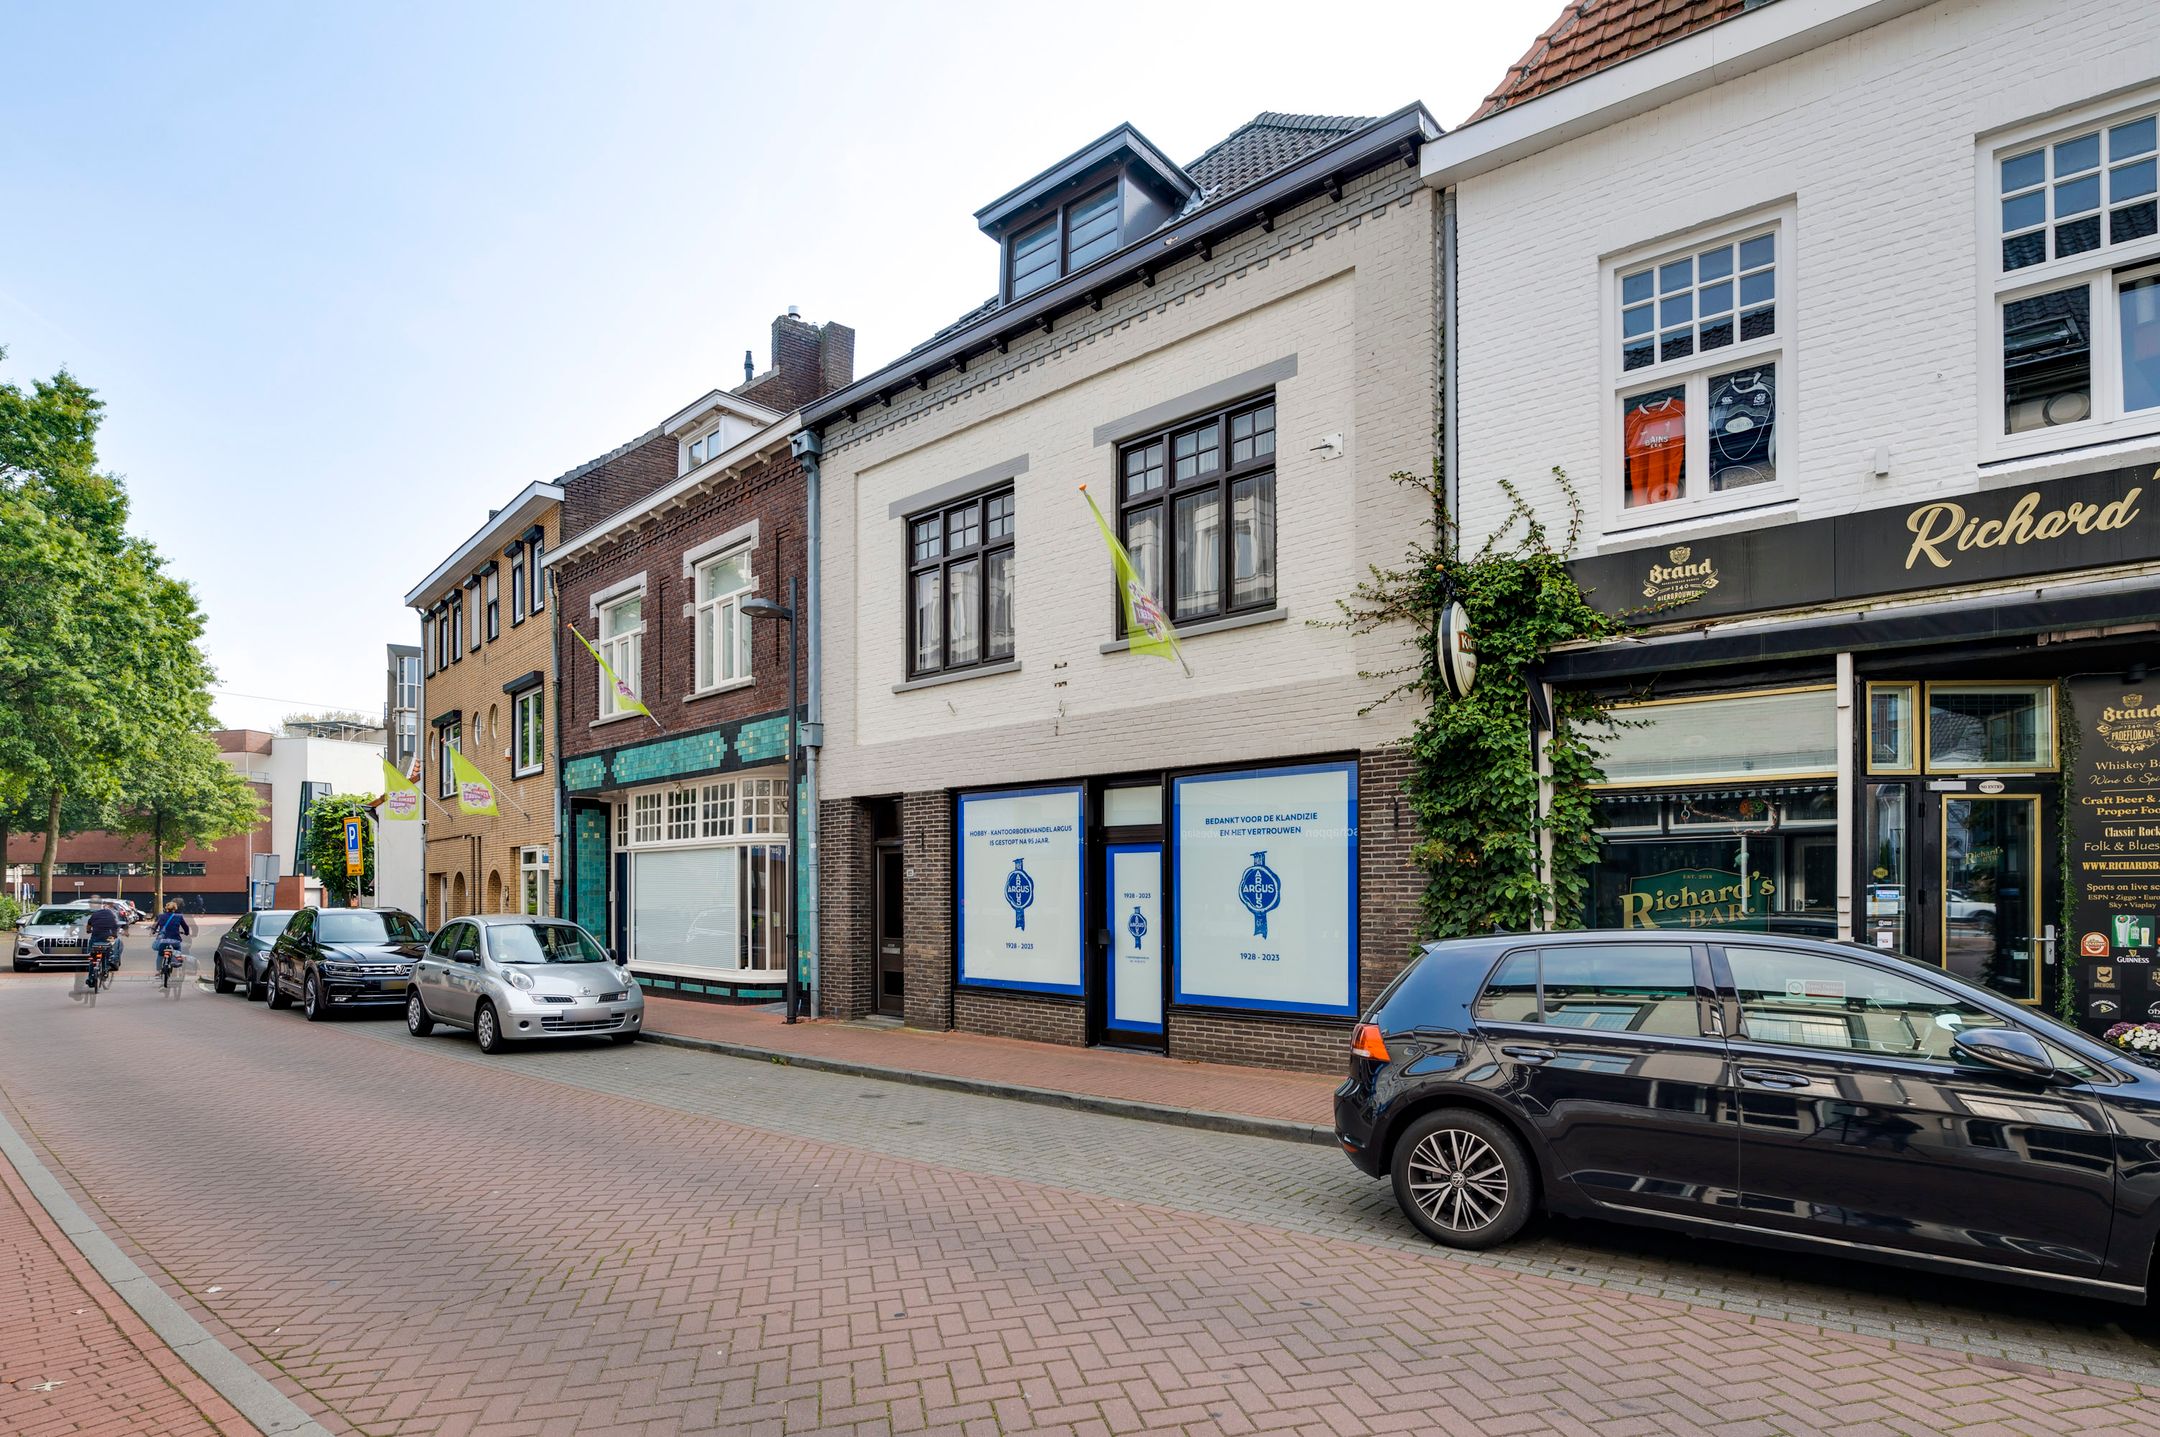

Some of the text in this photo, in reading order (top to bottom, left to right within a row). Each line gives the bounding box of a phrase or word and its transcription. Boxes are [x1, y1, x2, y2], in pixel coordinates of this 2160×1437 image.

[1649, 558, 1713, 584] Brand
[2103, 704, 2160, 722] Brand
[2111, 729, 2155, 740] PROEFLOKAAL
[2096, 759, 2160, 771] Whiskey B
[2089, 774, 2120, 785] Wine
[2123, 774, 2136, 783] &
[2082, 794, 2156, 805] Craft Beer &
[2096, 807, 2138, 817] Proper
[1205, 812, 1318, 825] BEDANKT VOOR DE KLANDIZIE
[991, 827, 1052, 836] KANTOORBOEKHANDEL
[1053, 825, 1073, 833] ARGUS
[1220, 829, 1231, 837] EN
[1231, 828, 1246, 836] HET
[1247, 826, 1302, 836] VERTROUWEN
[2105, 826, 2136, 838] Classic
[348, 826, 356, 848] P
[995, 838, 1019, 847] GESTOPT
[2084, 839, 2160, 851] Folk & Blues
[2082, 861, 2160, 871] WWW.RICHARDSB
[1007, 885, 1030, 893] ARGUS
[1242, 884, 1275, 893] ARGUS
[2086, 883, 2115, 893] Sports
[2131, 883, 2149, 891] live
[1618, 870, 1776, 929] Richard's
[2115, 894, 2137, 902] Ziggo
[1240, 952, 1257, 961] 1928
[1262, 953, 1280, 961] 2023
[2116, 956, 2150, 964] GUINNESS
